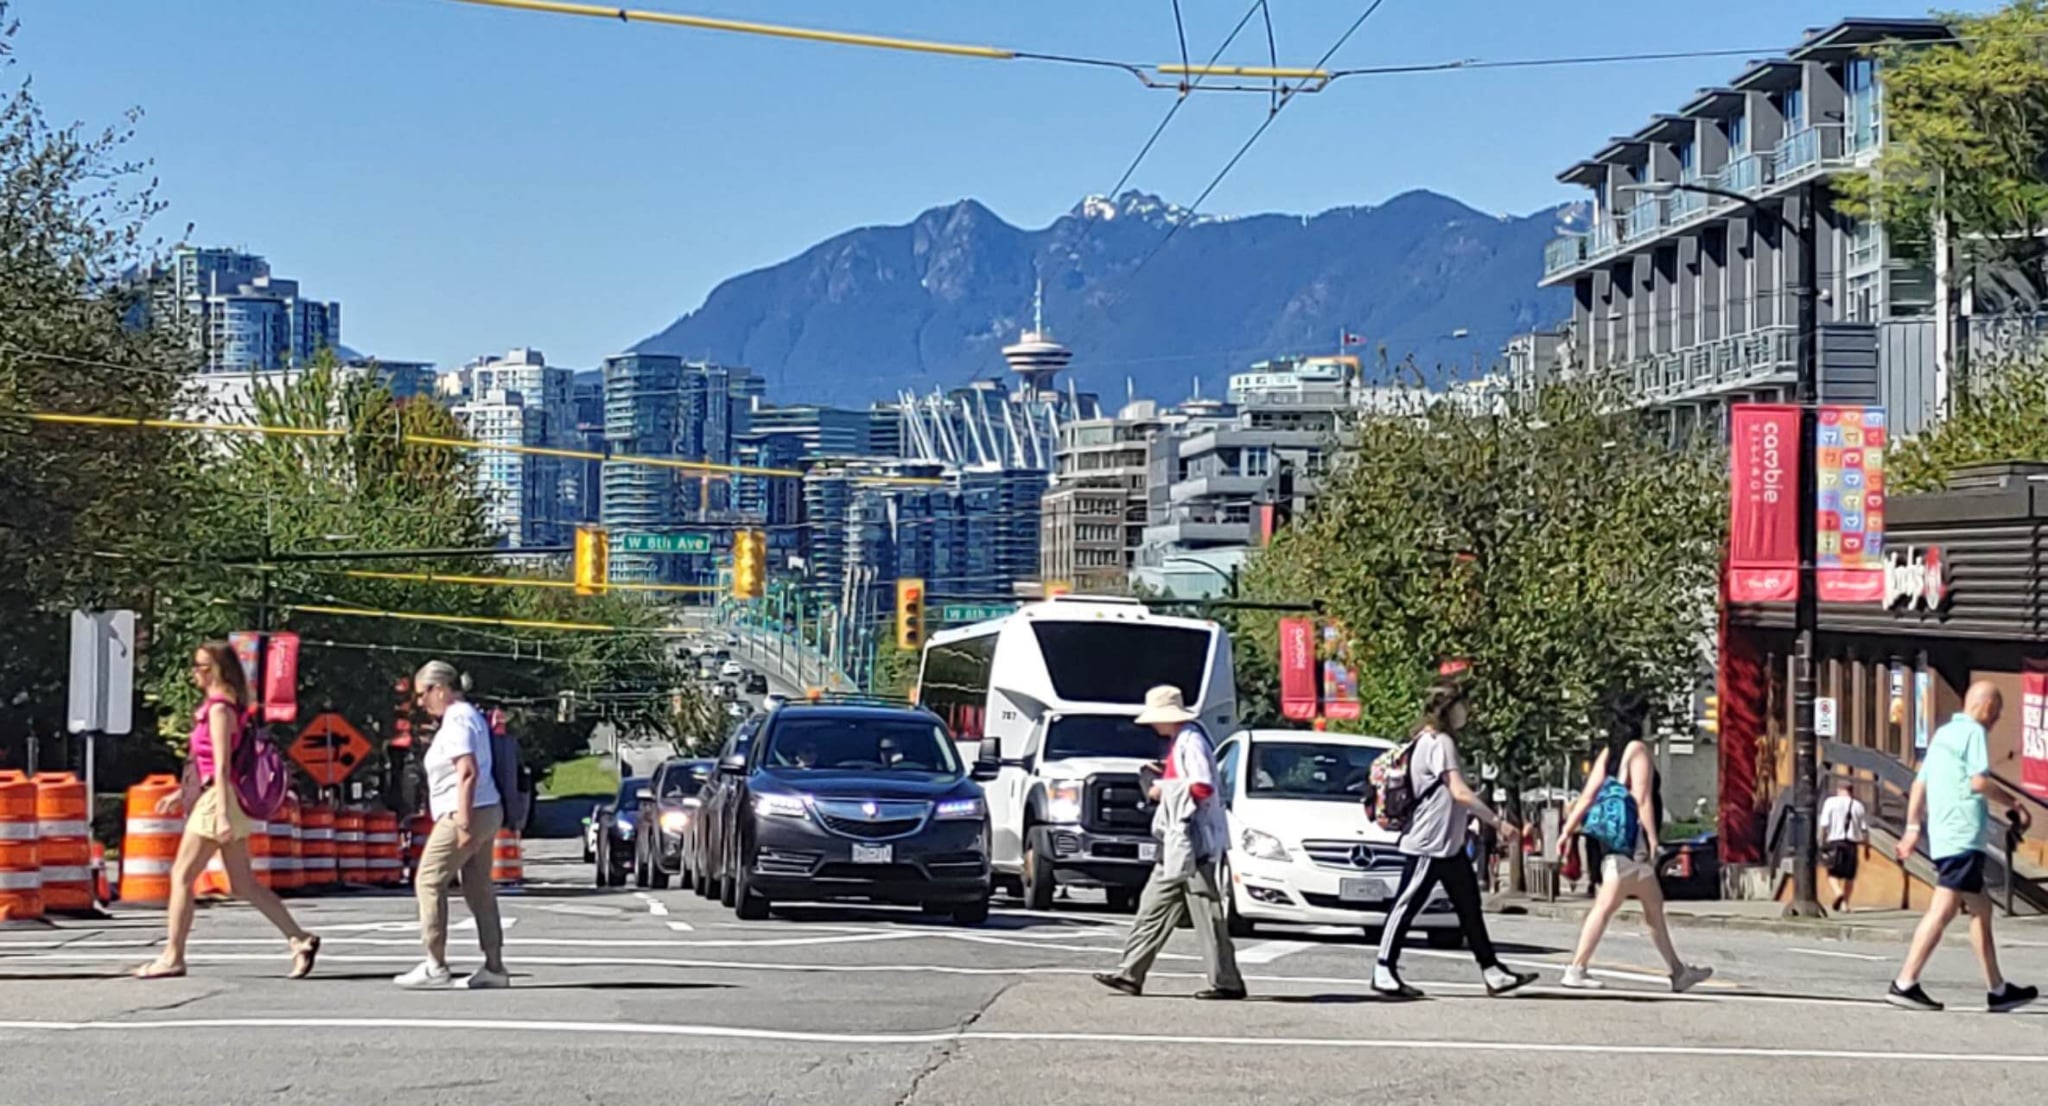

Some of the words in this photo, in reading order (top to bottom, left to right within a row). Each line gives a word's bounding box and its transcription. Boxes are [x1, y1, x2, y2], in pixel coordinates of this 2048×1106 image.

[1763, 421, 1783, 504] cambie
[628, 536, 641, 549] W
[677, 536, 704, 549] Ave
